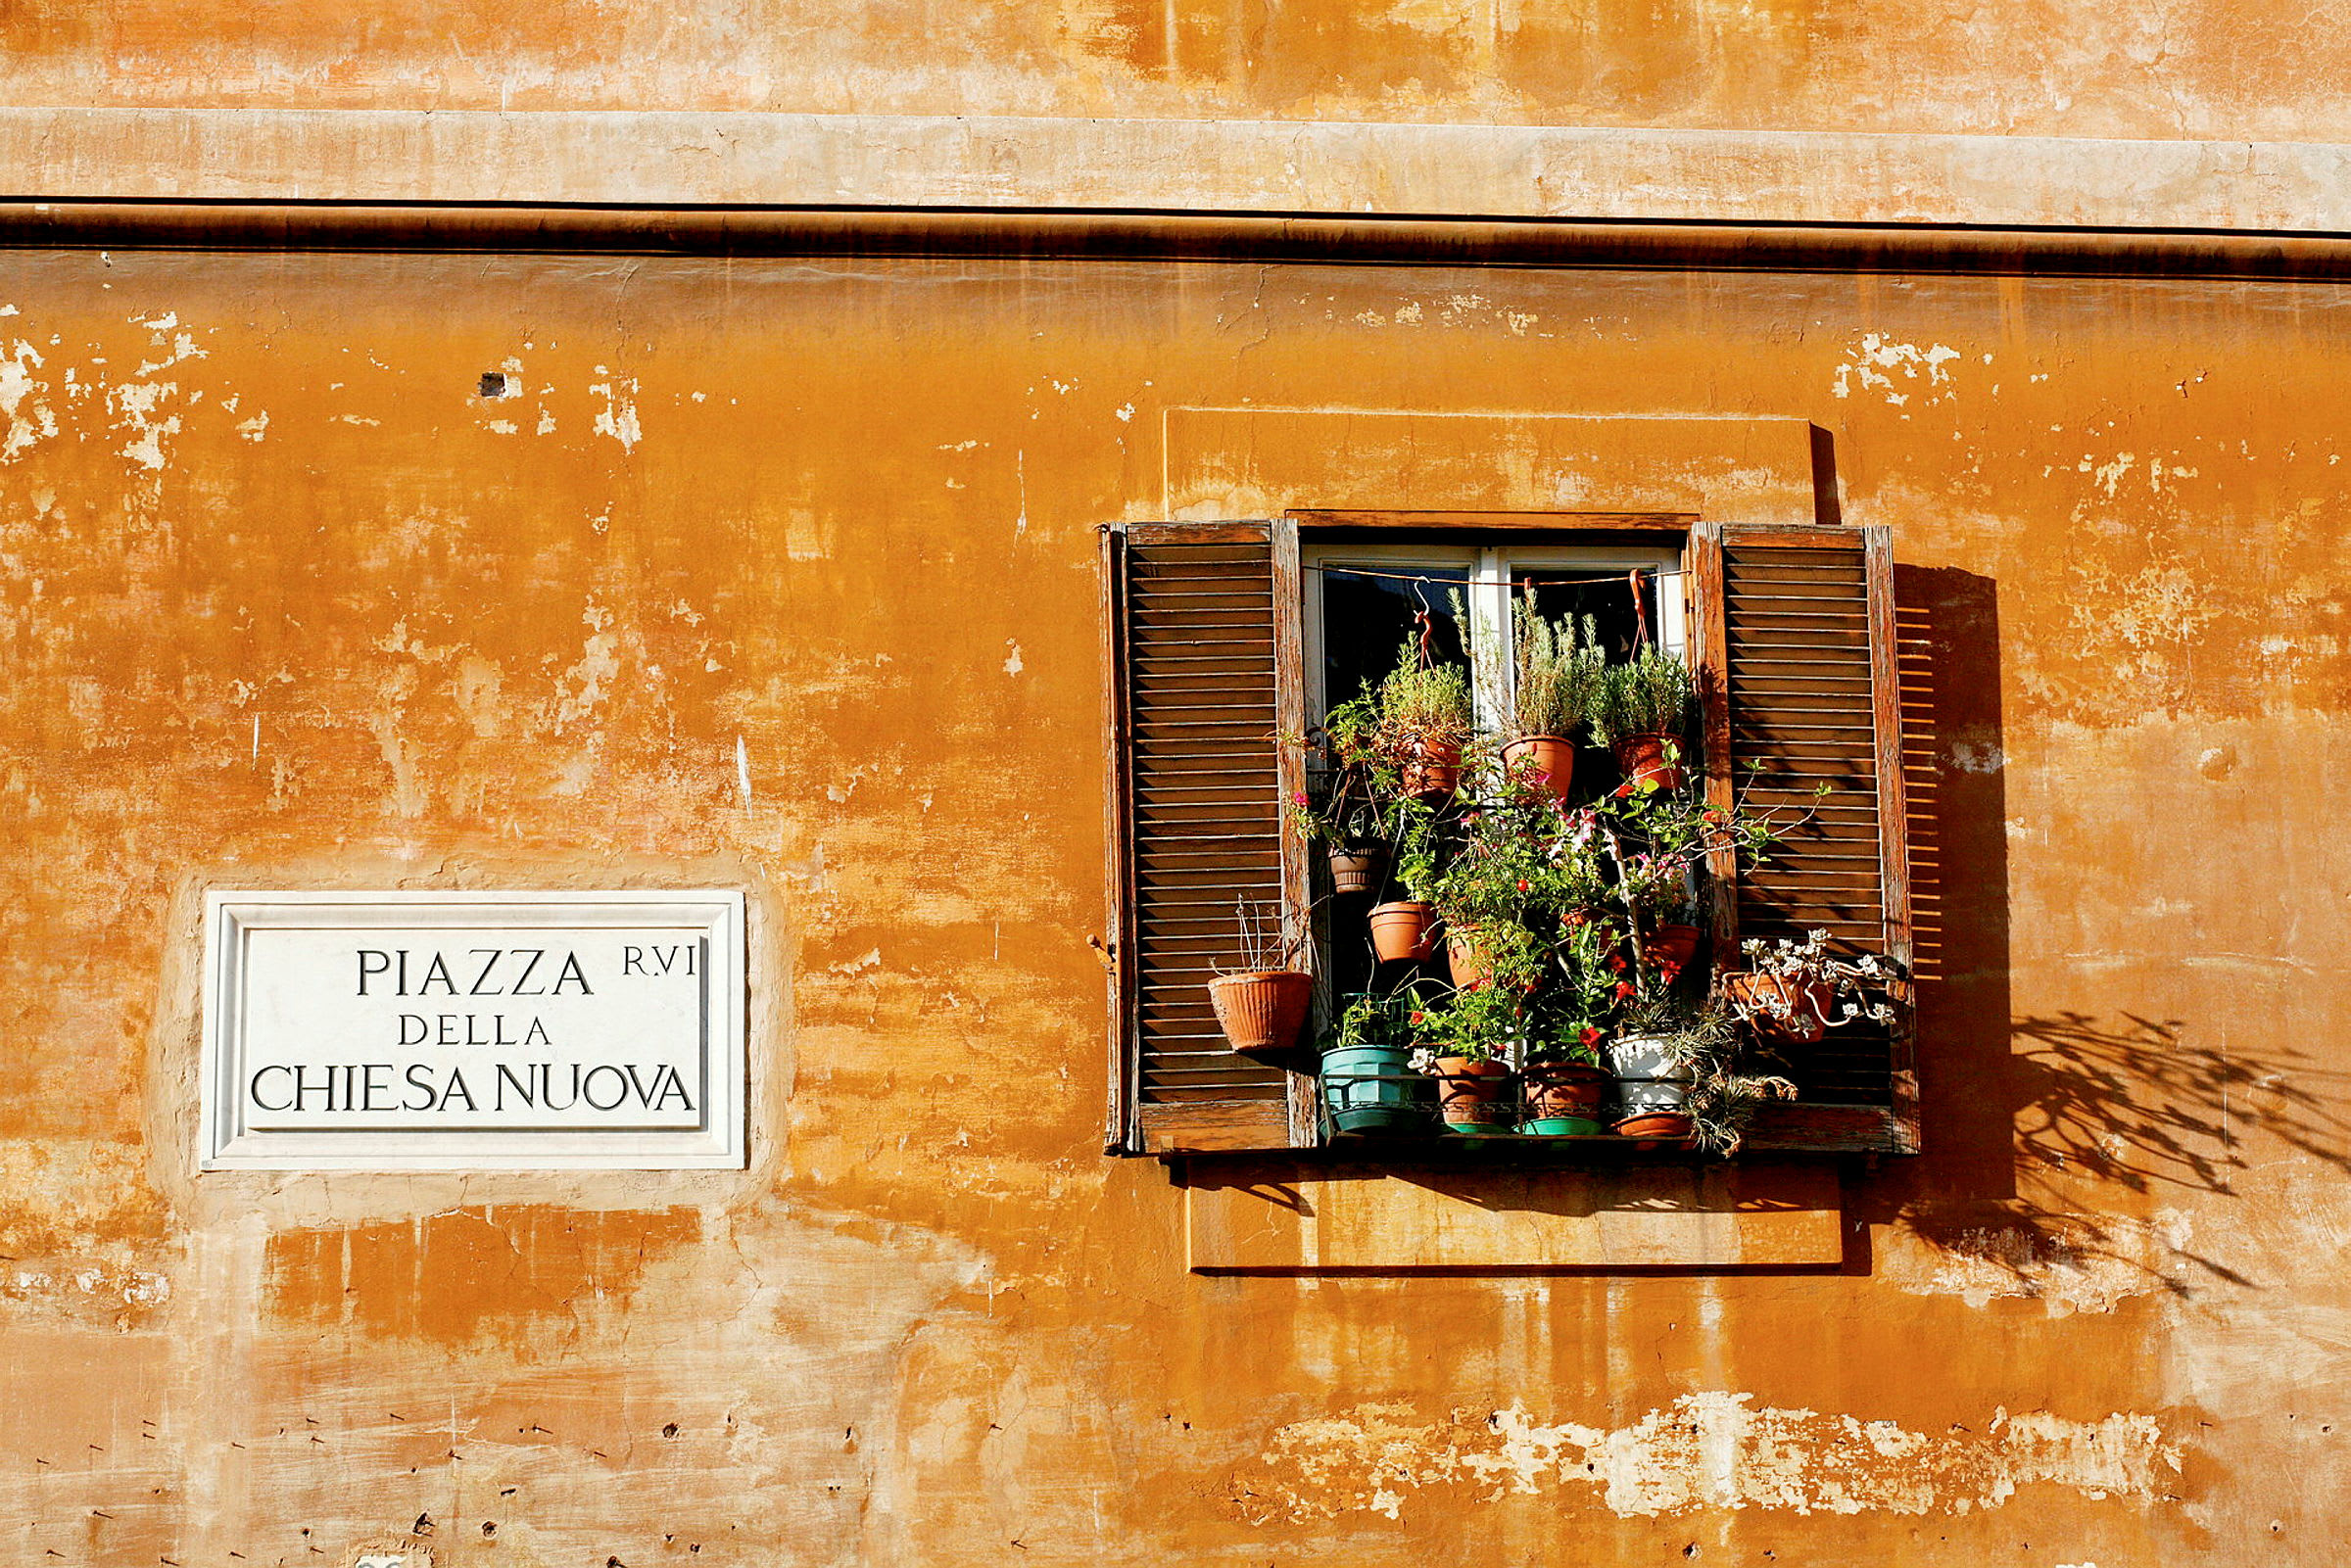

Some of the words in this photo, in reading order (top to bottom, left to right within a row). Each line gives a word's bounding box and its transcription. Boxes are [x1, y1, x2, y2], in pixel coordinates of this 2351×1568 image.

[356, 949, 595, 997] PIAZZA
[398, 1014, 552, 1046] DELLA
[250, 1064, 479, 1113] CHIESA
[494, 1063, 696, 1112] NUOVA
